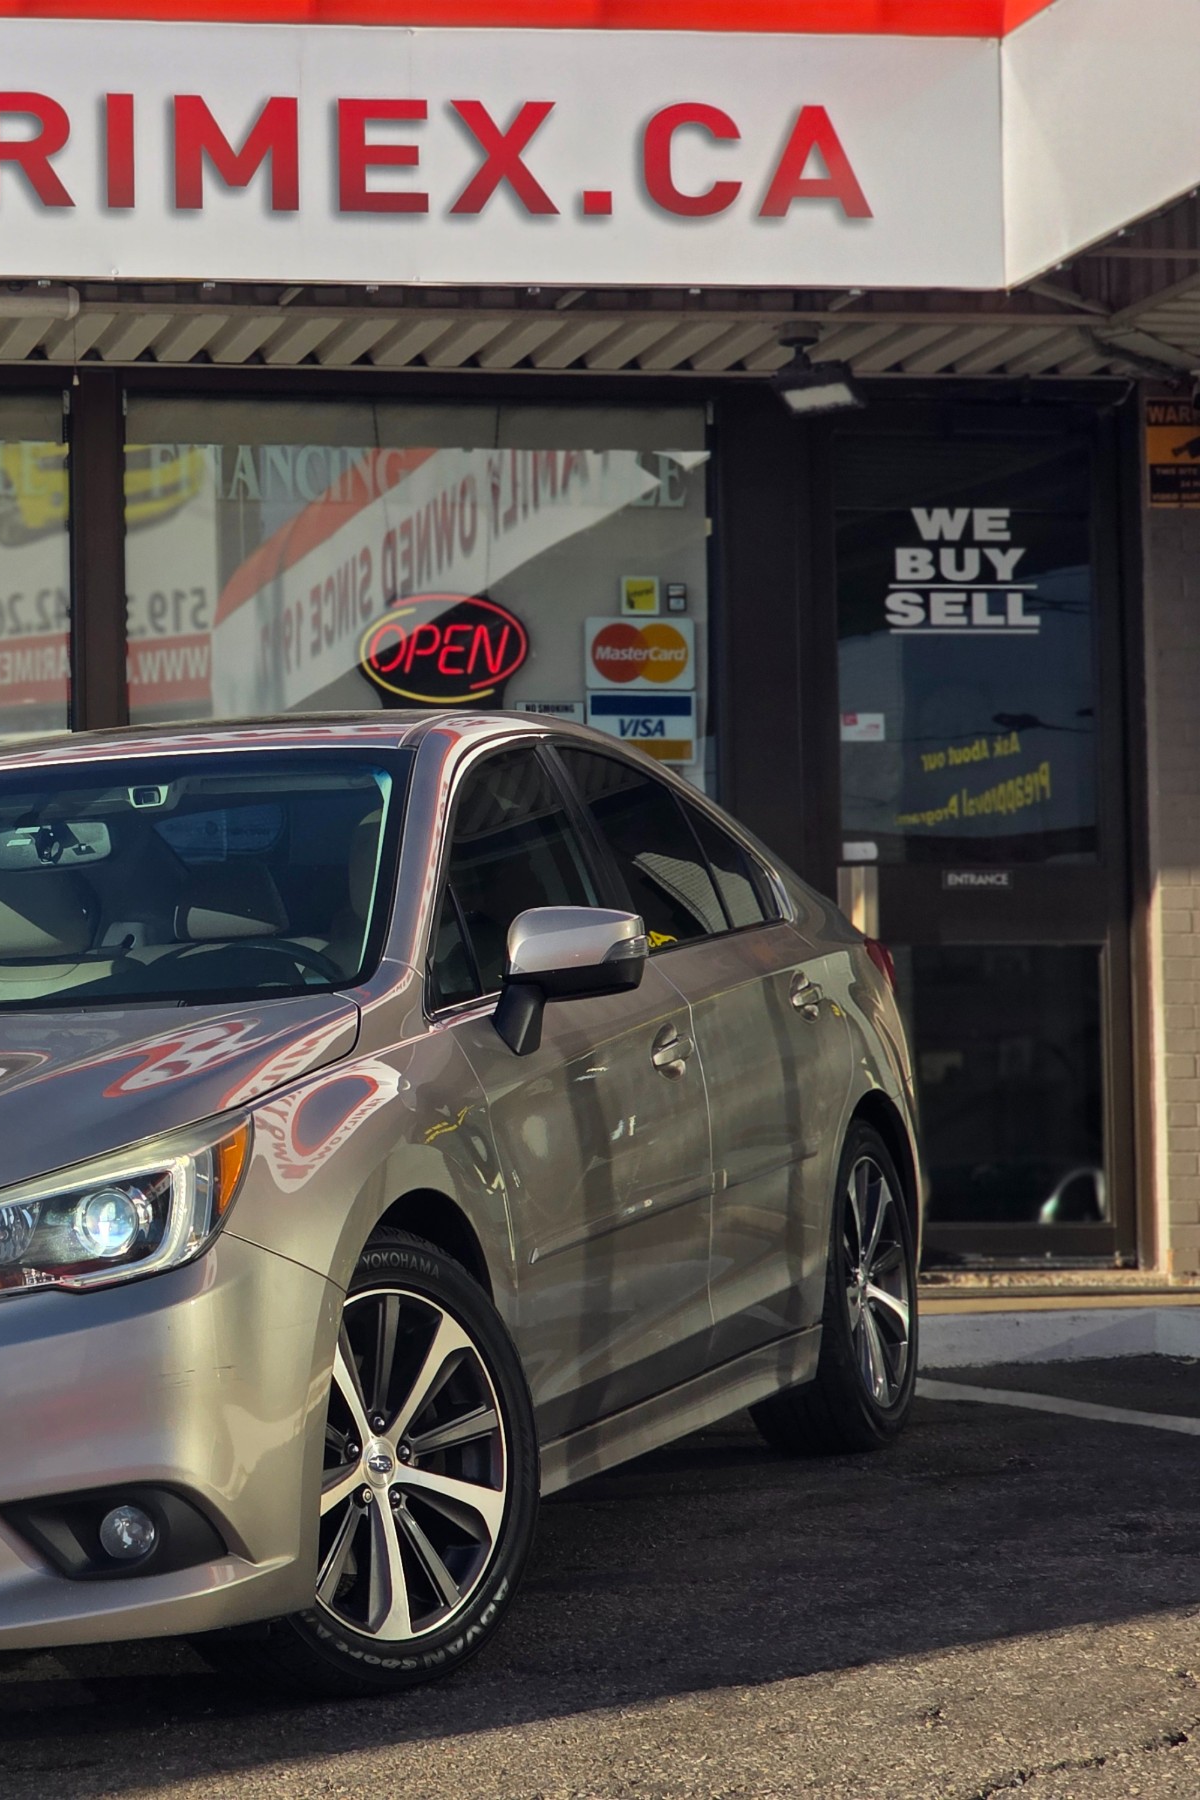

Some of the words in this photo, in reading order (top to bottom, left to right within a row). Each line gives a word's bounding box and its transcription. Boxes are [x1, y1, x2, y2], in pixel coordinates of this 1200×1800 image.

[1148, 405, 1200, 424] WAR
[912, 508, 1011, 541] WE
[895, 548, 1025, 580] BUY
[885, 592, 1040, 626] SELL
[370, 623, 510, 674] OPEN
[595, 645, 686, 661] MasterCard
[525, 704, 536, 713] NO
[538, 704, 575, 713] SMOKING
[618, 718, 666, 738] VISA
[947, 873, 1009, 886] ENTRANCE
[362, 1251, 440, 1280] YOKOHAMA
